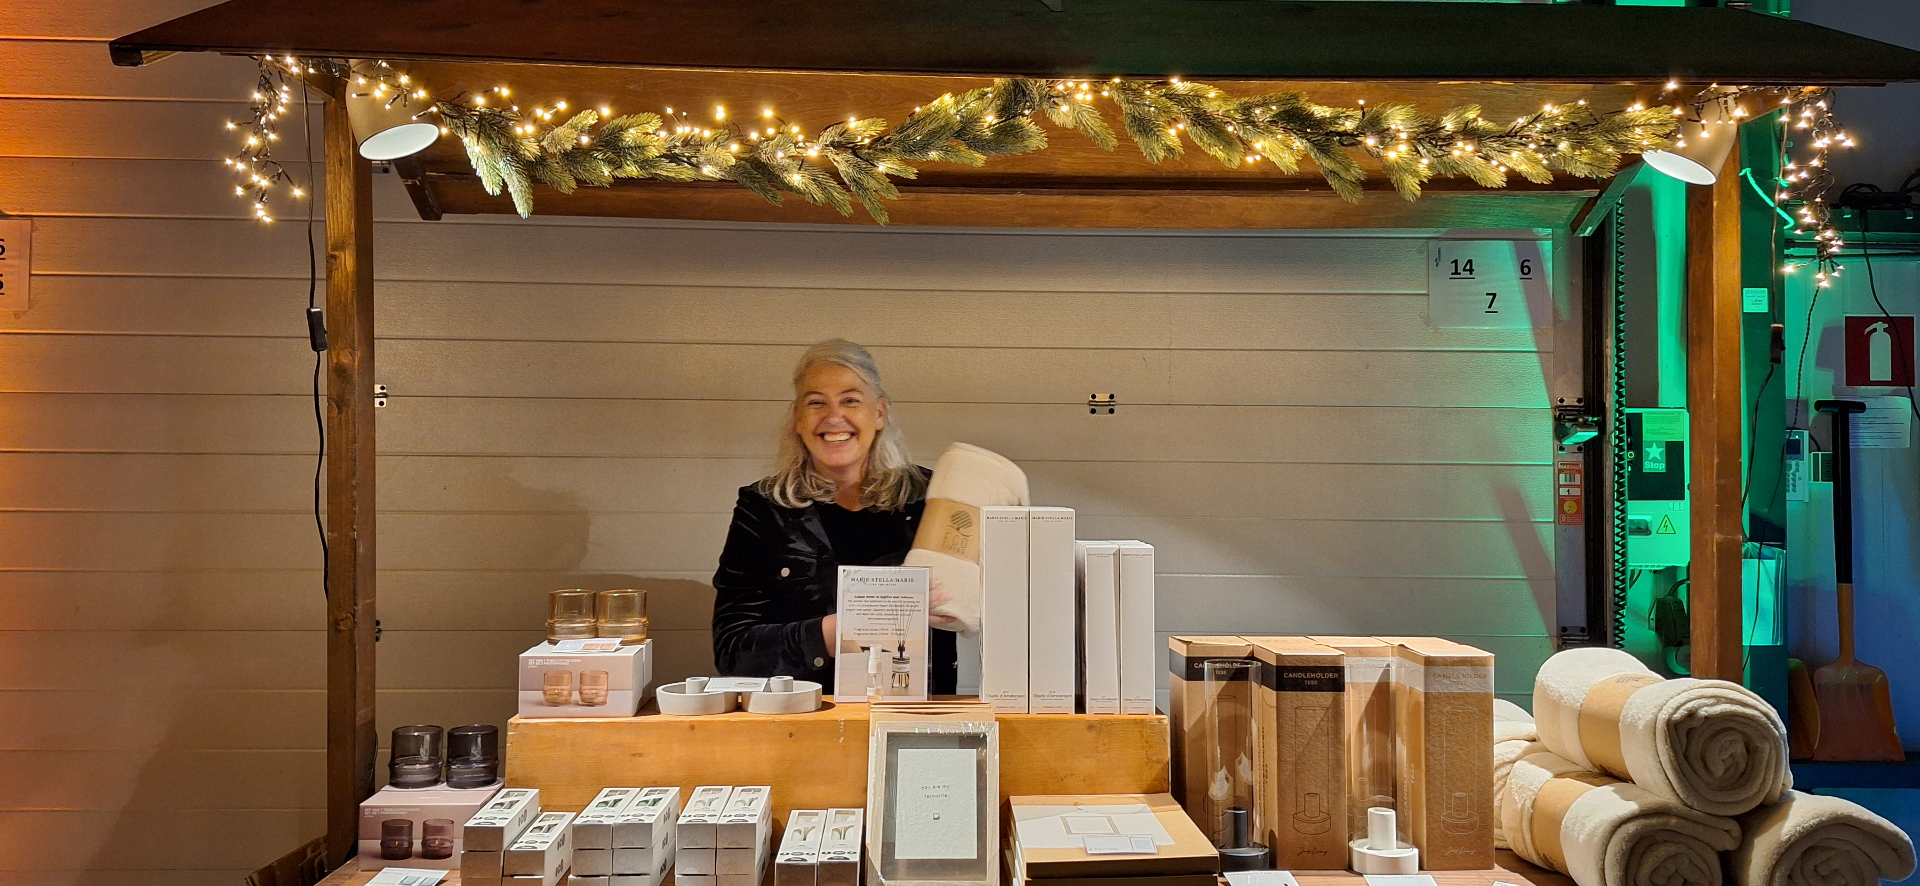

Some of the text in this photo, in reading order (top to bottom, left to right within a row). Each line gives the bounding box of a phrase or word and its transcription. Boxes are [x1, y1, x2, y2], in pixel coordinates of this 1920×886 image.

[1450, 258, 1475, 276] 14
[1520, 258, 1532, 276] 6
[1485, 292, 1498, 310] 7
[1644, 461, 1665, 470] Stop
